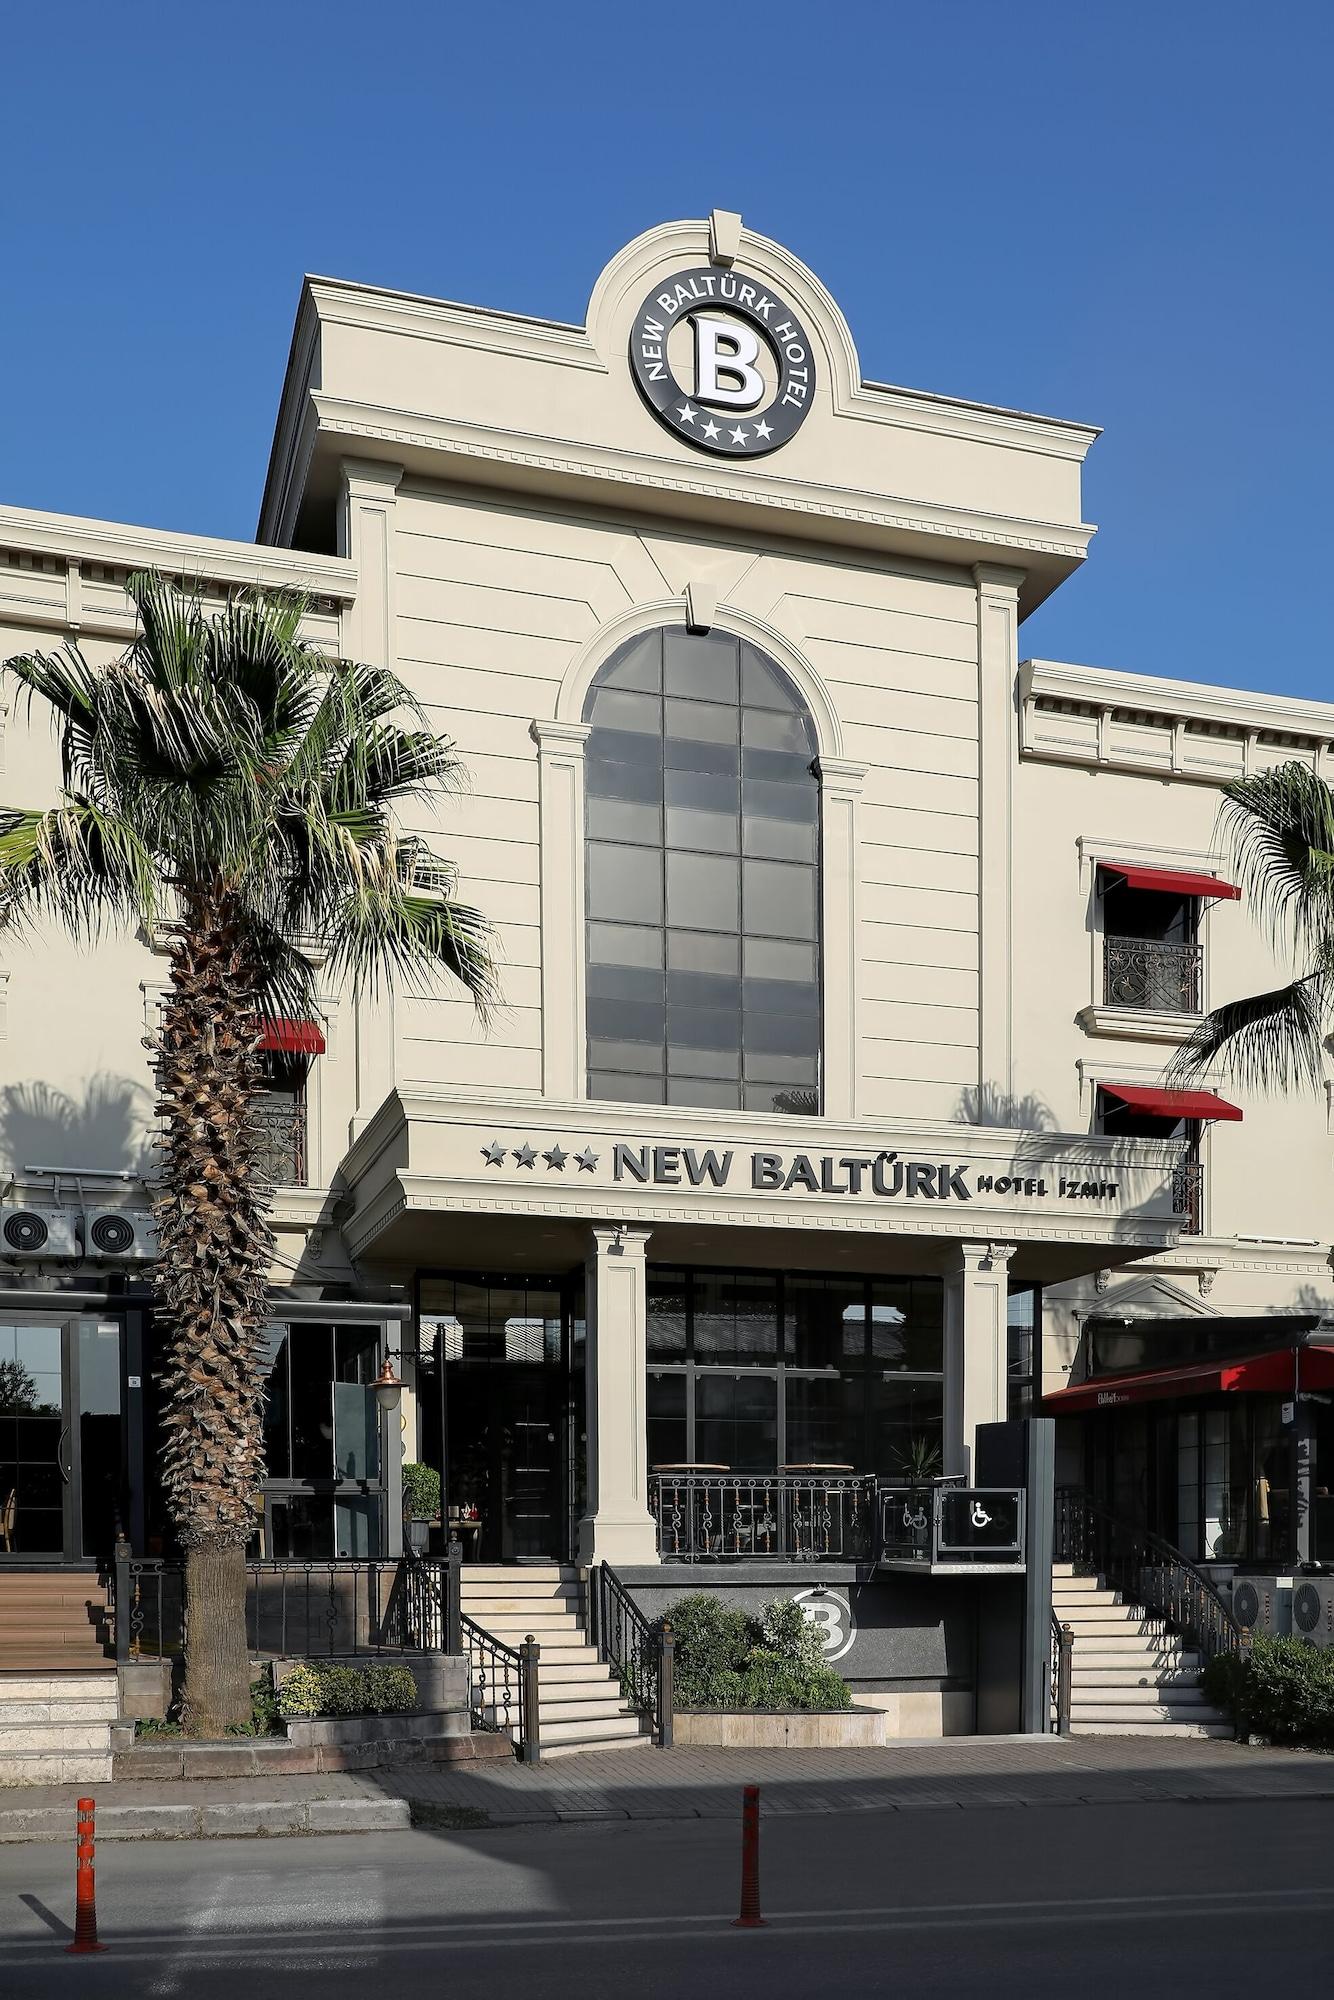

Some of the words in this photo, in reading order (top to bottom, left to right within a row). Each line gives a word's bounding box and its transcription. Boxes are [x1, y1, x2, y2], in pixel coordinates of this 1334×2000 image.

[641, 315, 669, 381] NEW
[656, 273, 776, 320] BALTÜRK
[775, 321, 808, 408] HOTEL
[688, 315, 766, 409] B
[612, 1143, 734, 1187] NEW
[750, 1152, 973, 1200] BALTÜRK
[977, 1175, 1048, 1197] HOTEL
[799, 1602, 844, 1650] B
